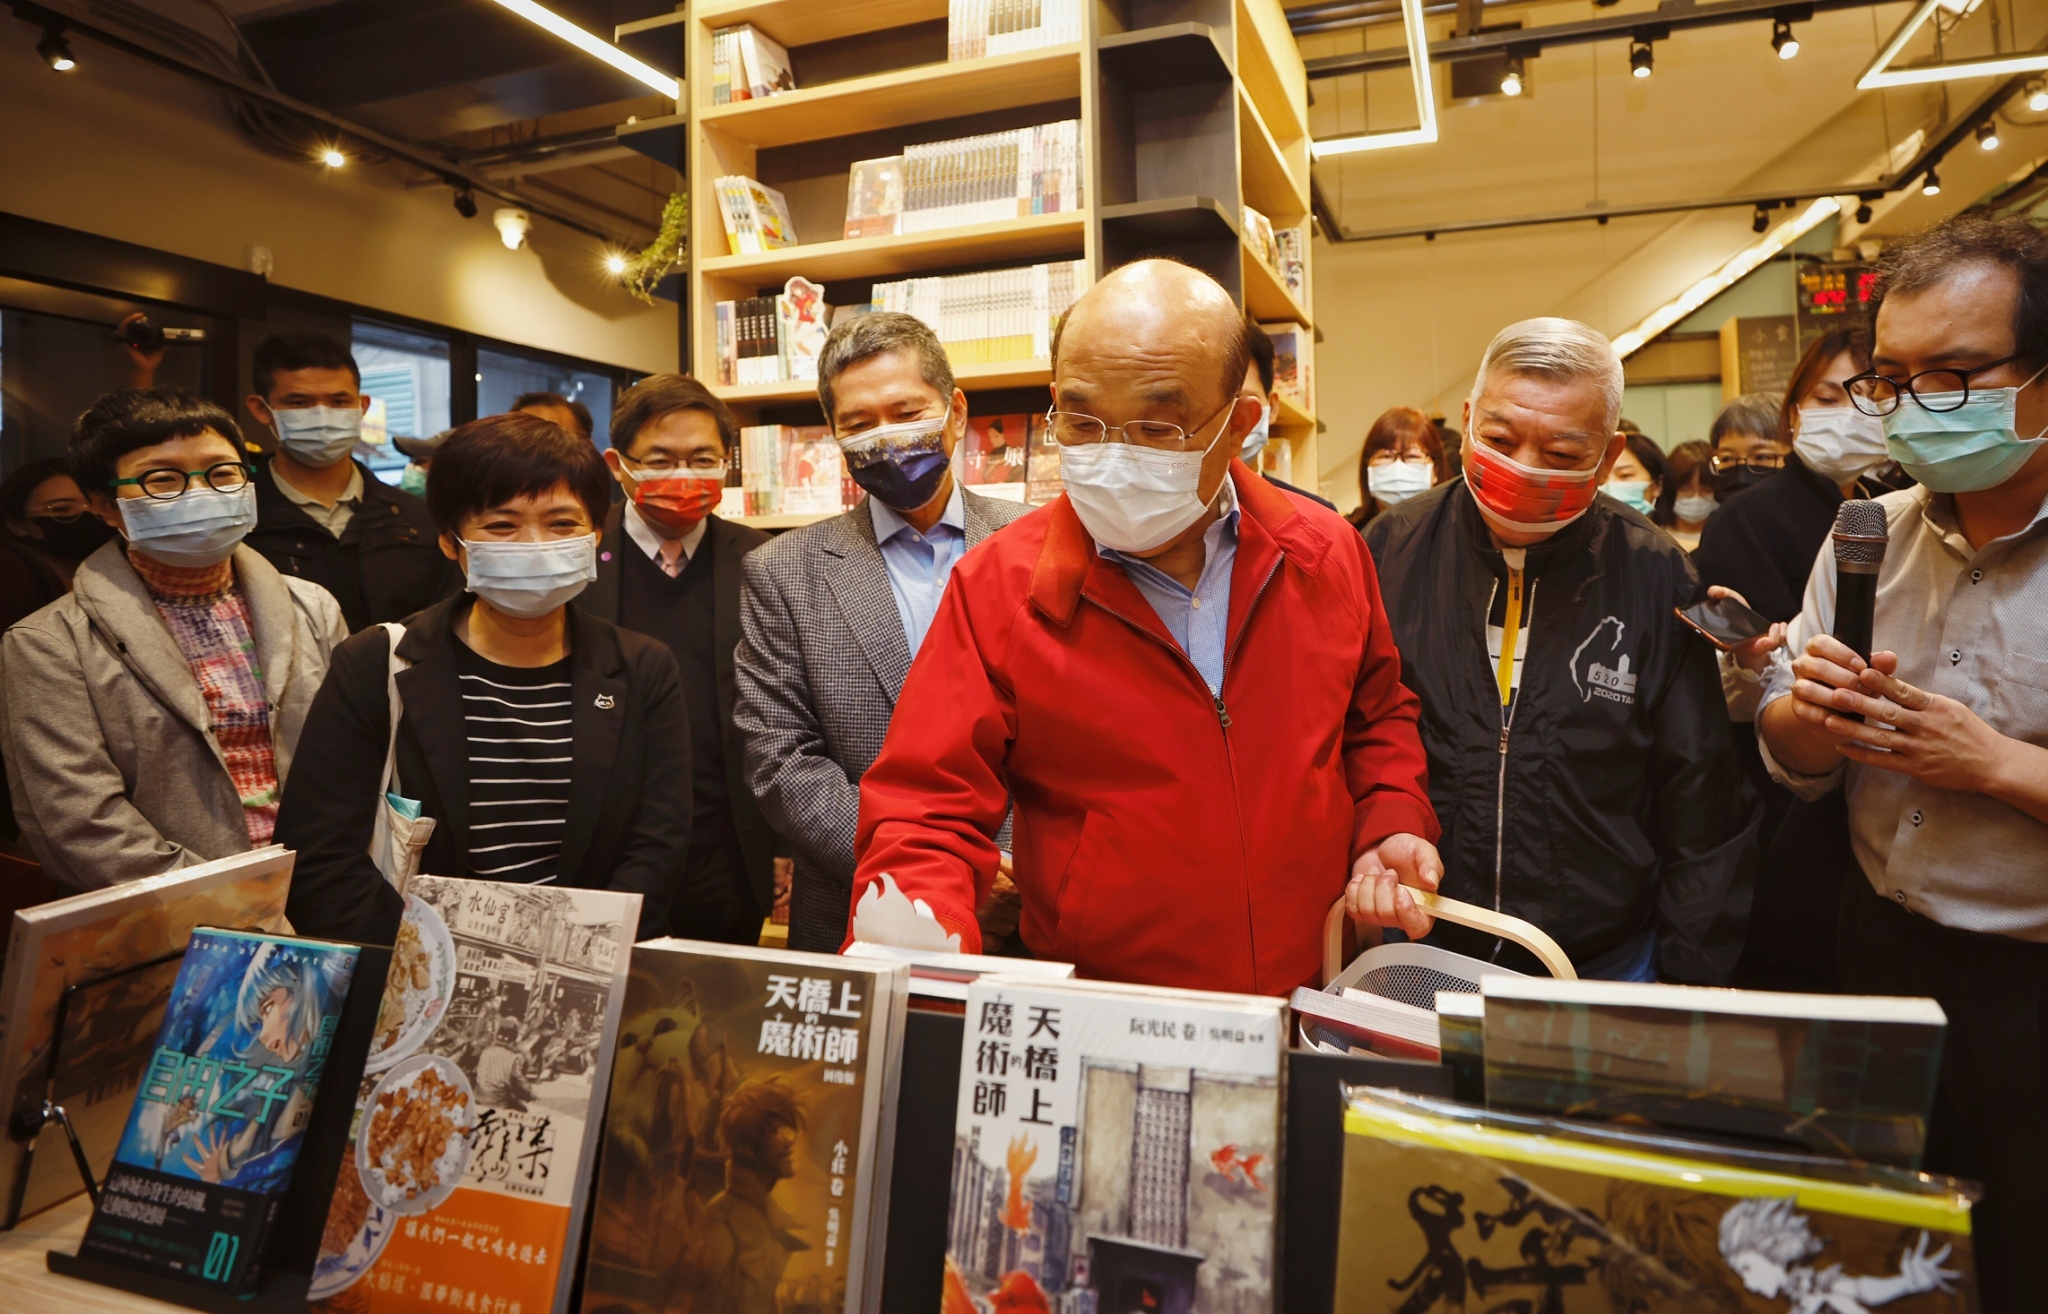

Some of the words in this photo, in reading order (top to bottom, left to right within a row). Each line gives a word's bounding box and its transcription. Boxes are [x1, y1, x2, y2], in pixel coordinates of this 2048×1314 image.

[1593, 671, 1619, 687] 520
[467, 890, 510, 924] 水仙宮
[192, 939, 228, 953] Sons
[764, 974, 862, 1018] 天橋上
[804, 1012, 819, 1025] 的
[757, 1013, 860, 1065] 魔術師
[1129, 1018, 1176, 1040] 阮光民
[304, 1014, 339, 1098] 自由之子
[972, 993, 1014, 1118] 魔術師
[1019, 1005, 1061, 1126] 天橋上
[141, 1045, 295, 1124] 自由之子
[203, 1231, 240, 1283] 01
